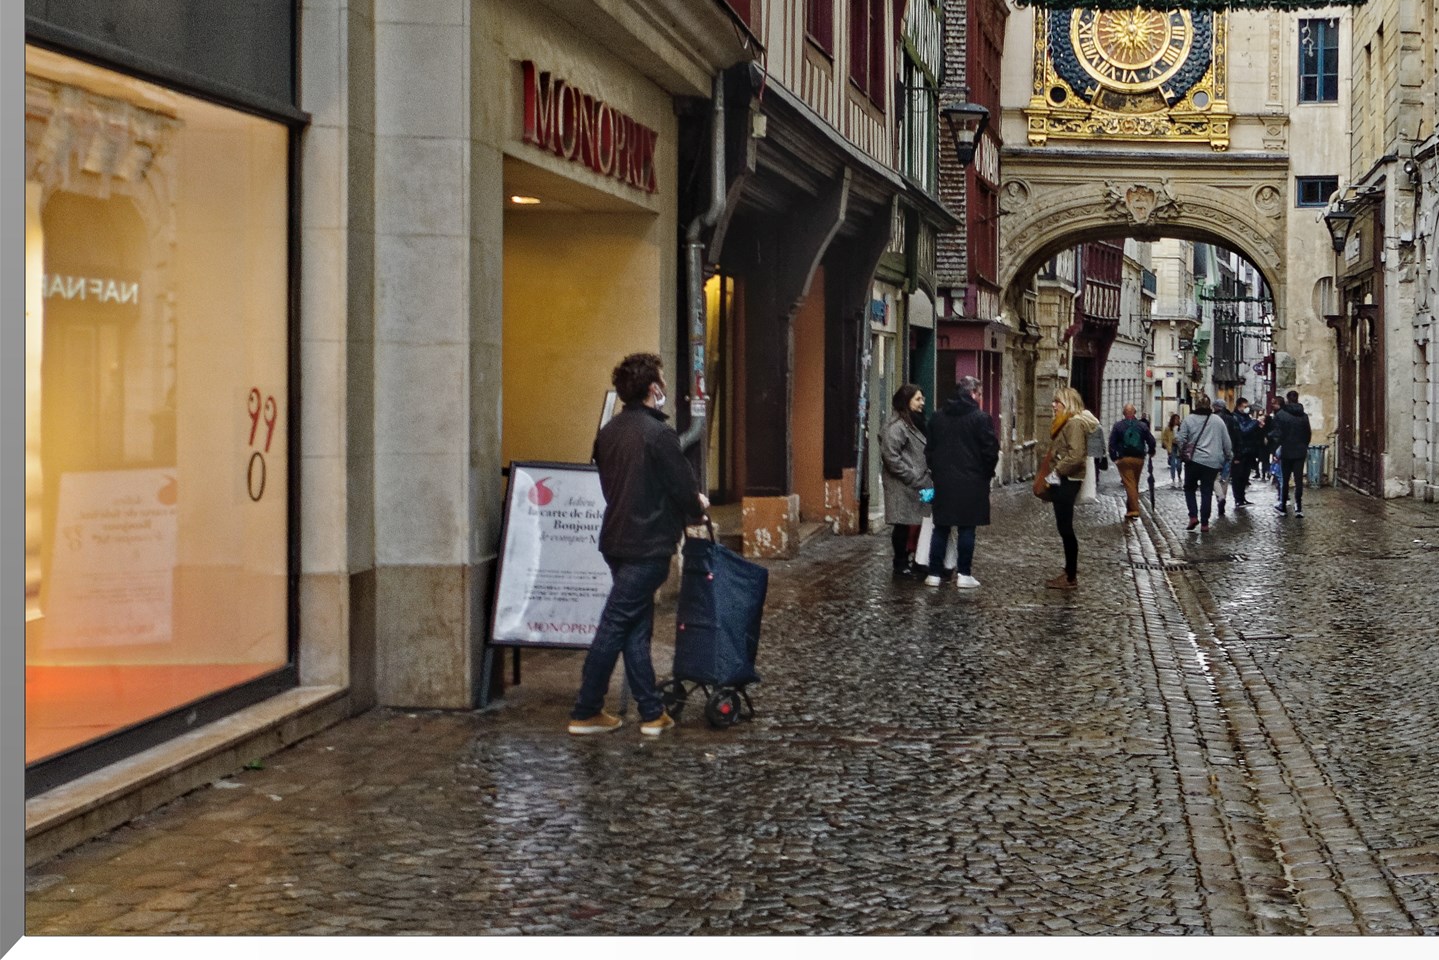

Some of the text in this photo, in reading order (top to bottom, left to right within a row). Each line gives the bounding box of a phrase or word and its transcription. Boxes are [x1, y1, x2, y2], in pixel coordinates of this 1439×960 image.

[521, 59, 659, 194] MONOPRIX
[540, 509, 568, 518] carte
[570, 508, 582, 518] de
[553, 520, 600, 533] Bonjour
